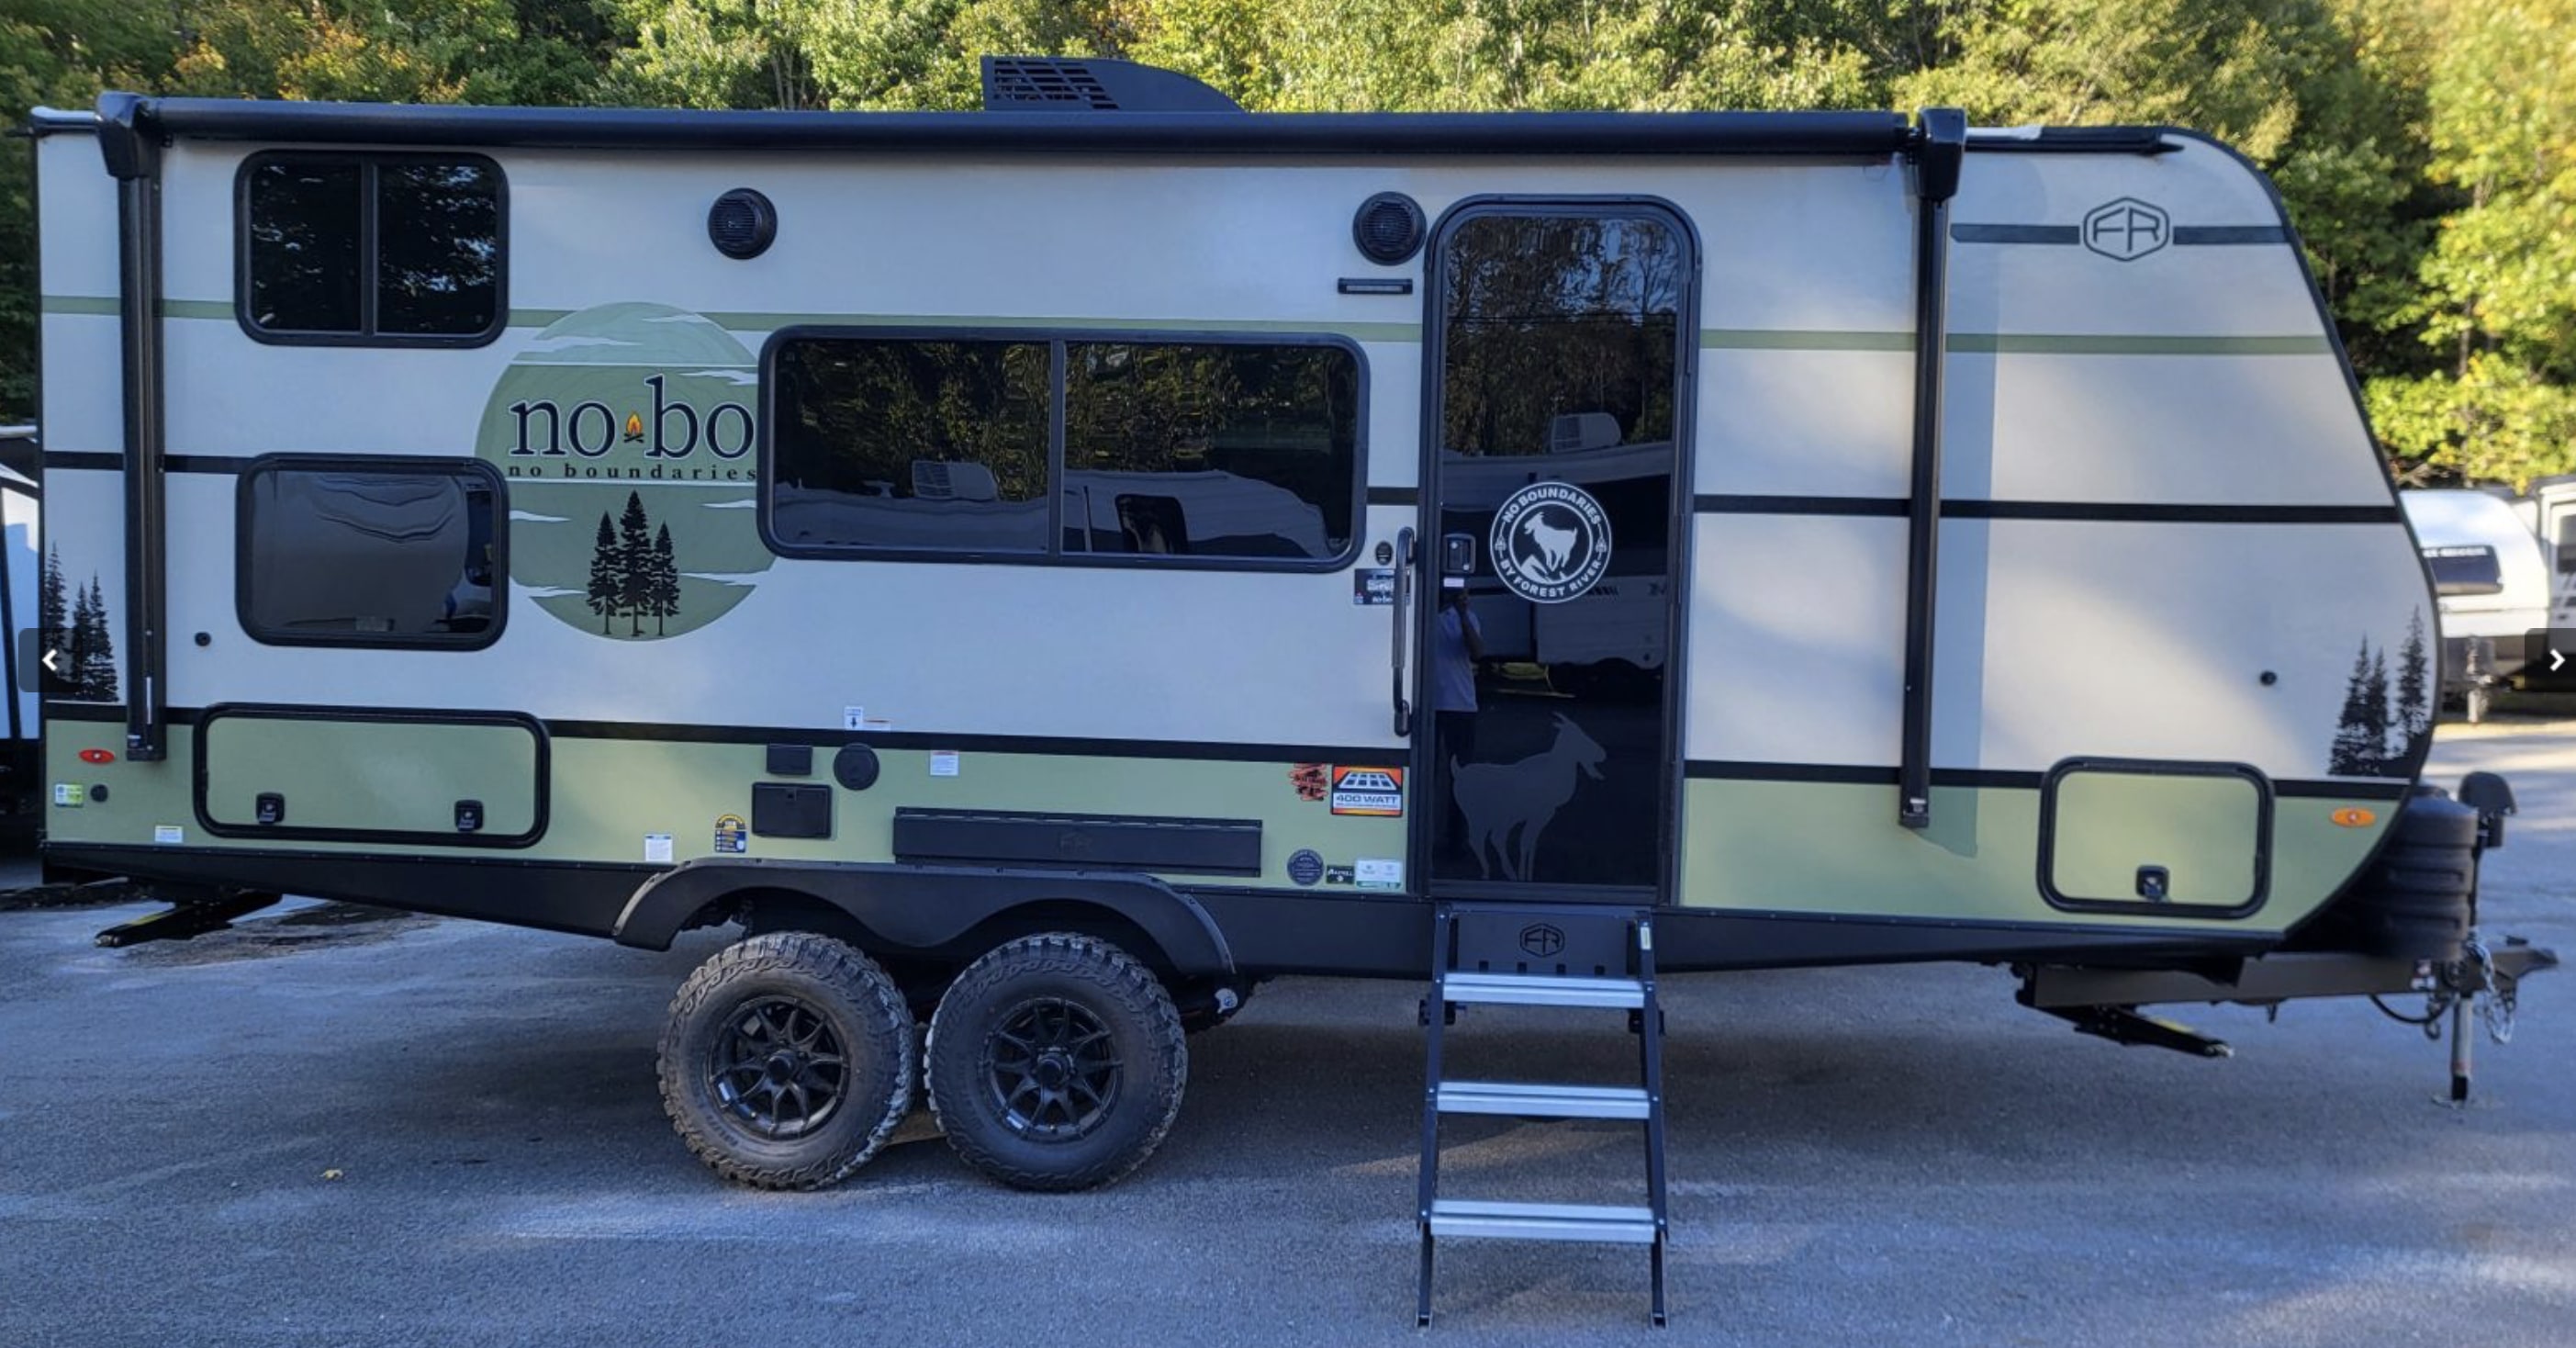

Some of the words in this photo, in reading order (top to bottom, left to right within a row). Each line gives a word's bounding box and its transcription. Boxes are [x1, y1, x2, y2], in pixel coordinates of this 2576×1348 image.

[2092, 205, 2161, 253] FR
[509, 465, 543, 477] no
[565, 463, 757, 480] boundaries
[1502, 503, 1520, 523] NO
[1518, 487, 1602, 525] BOUNDARIES
[1499, 558, 1517, 577] BY
[1513, 575, 1565, 598] FOREST
[1568, 558, 1602, 591] RIVER
[1336, 793, 1361, 803] 400
[1363, 794, 1398, 804] WATT
[1523, 927, 1561, 954] FR
